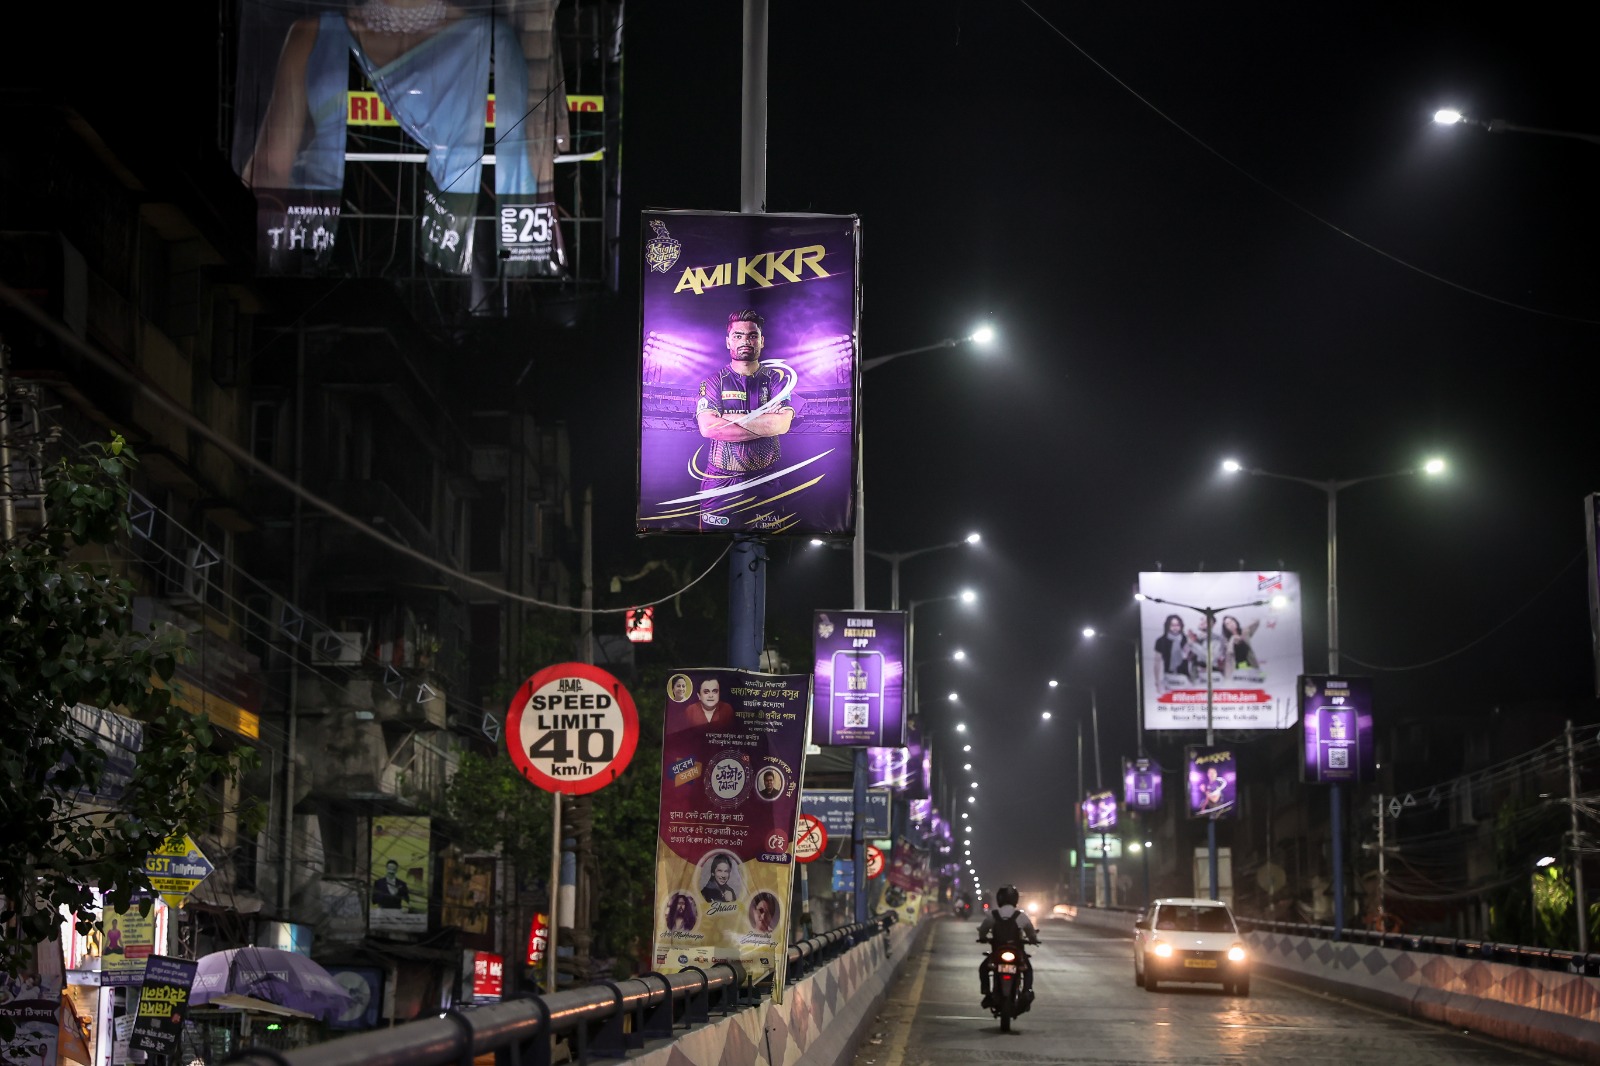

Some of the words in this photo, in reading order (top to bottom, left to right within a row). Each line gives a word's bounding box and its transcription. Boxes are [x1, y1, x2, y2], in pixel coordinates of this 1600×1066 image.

[501, 208, 518, 243] UPTO
[648, 243, 679, 255] Knight
[647, 252, 678, 263] Riders
[673, 262, 732, 295] AMI
[737, 244, 831, 288] KKR
[852, 638, 869, 648] APP
[730, 687, 761, 696] অধ্যাপক
[782, 689, 800, 701] বসুর
[532, 694, 612, 711] SPEED
[538, 713, 605, 730] LIMIT
[530, 729, 614, 764] 40
[551, 762, 593, 776] km/h
[672, 757, 694, 775] প্রবেশ
[679, 766, 699, 781] অবাধ
[718, 780, 738, 792] মেলা
[732, 812, 744, 822] মাঠ
[678, 826, 694, 834] থেকে
[714, 837, 729, 845] থেকে
[768, 834, 785, 851] ৫ই
[145, 858, 171, 872] GST
[172, 863, 207, 876] TallyPrime
[706, 900, 738, 916] Shaan
[141, 985, 187, 1007] বইমেলা
[25, 1006, 53, 1017] ঠিকানা
[138, 1001, 172, 1018] দমদম
